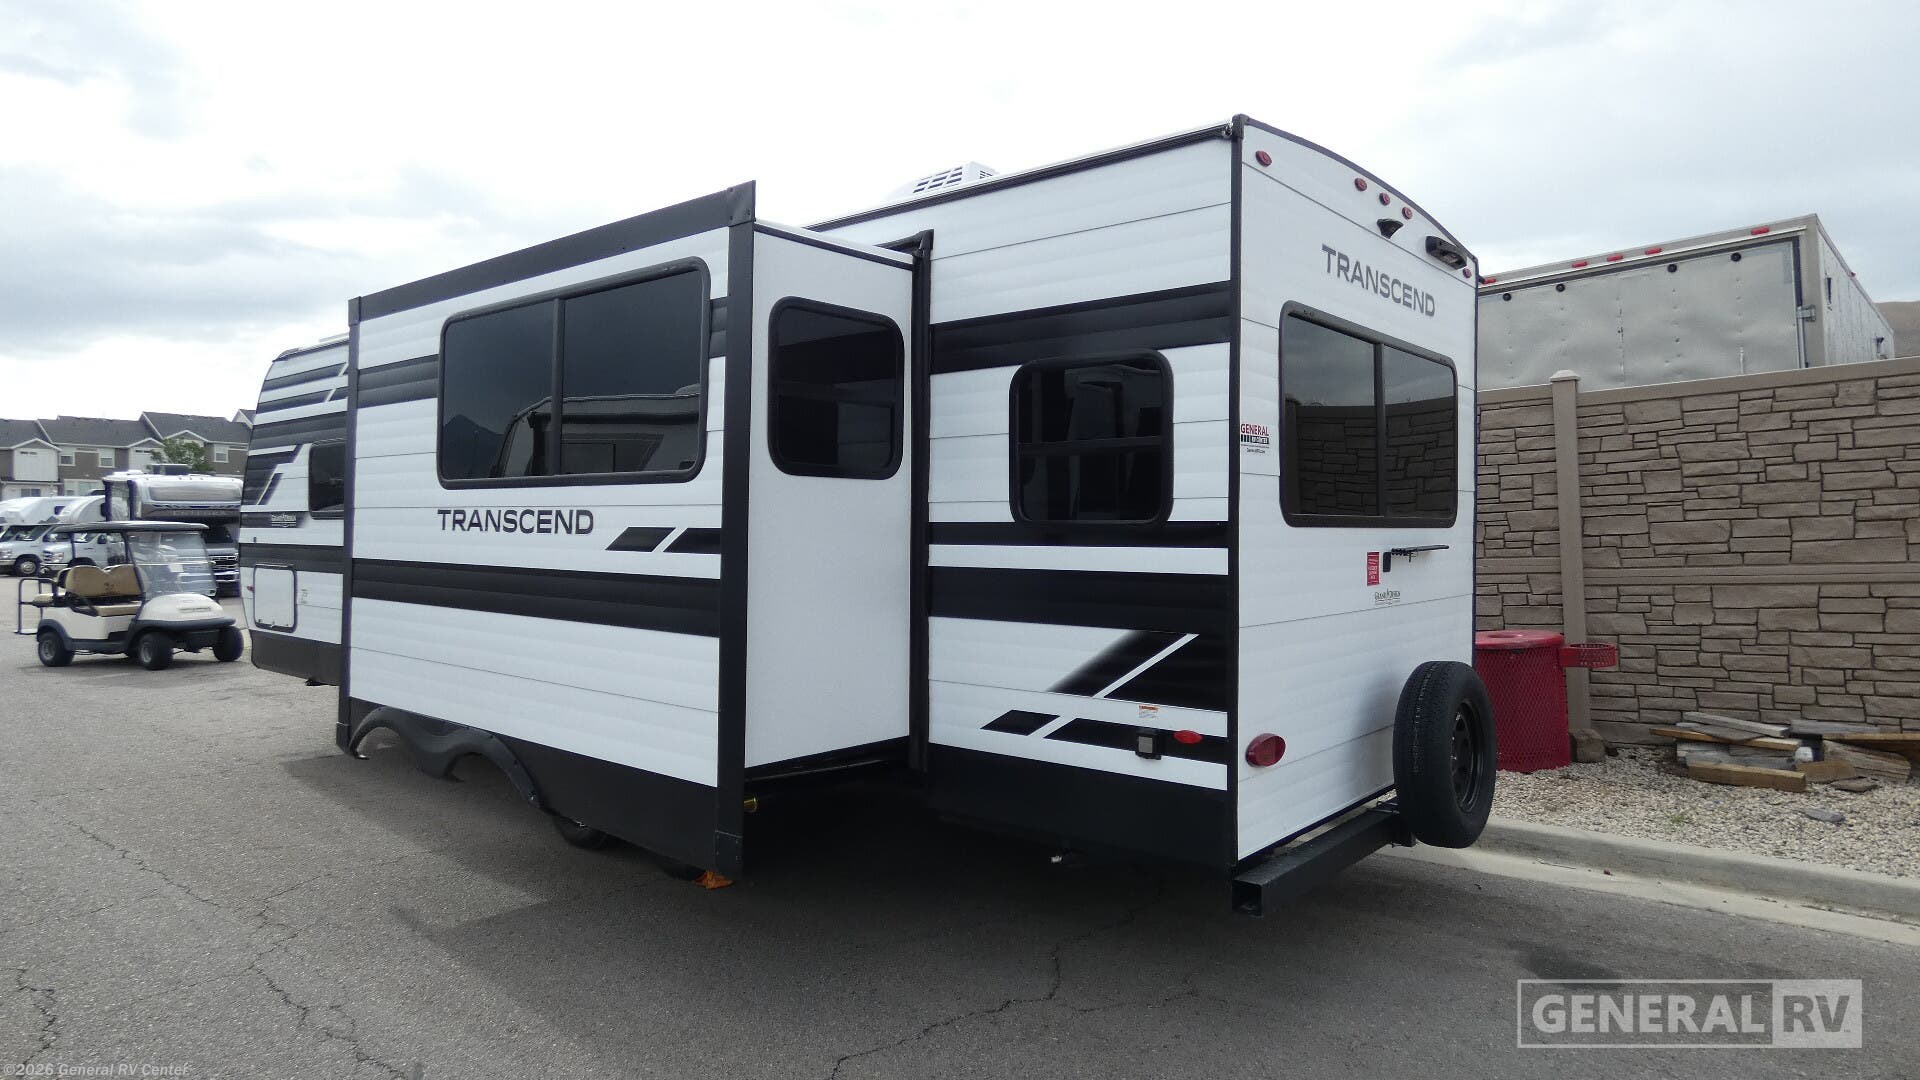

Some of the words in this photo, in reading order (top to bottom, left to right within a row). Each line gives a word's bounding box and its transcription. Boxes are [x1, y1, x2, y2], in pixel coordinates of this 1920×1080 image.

[1321, 243, 1436, 317] TRANSCEND
[1241, 424, 1269, 436] GENERAL
[437, 509, 594, 534] TRANSCEND
